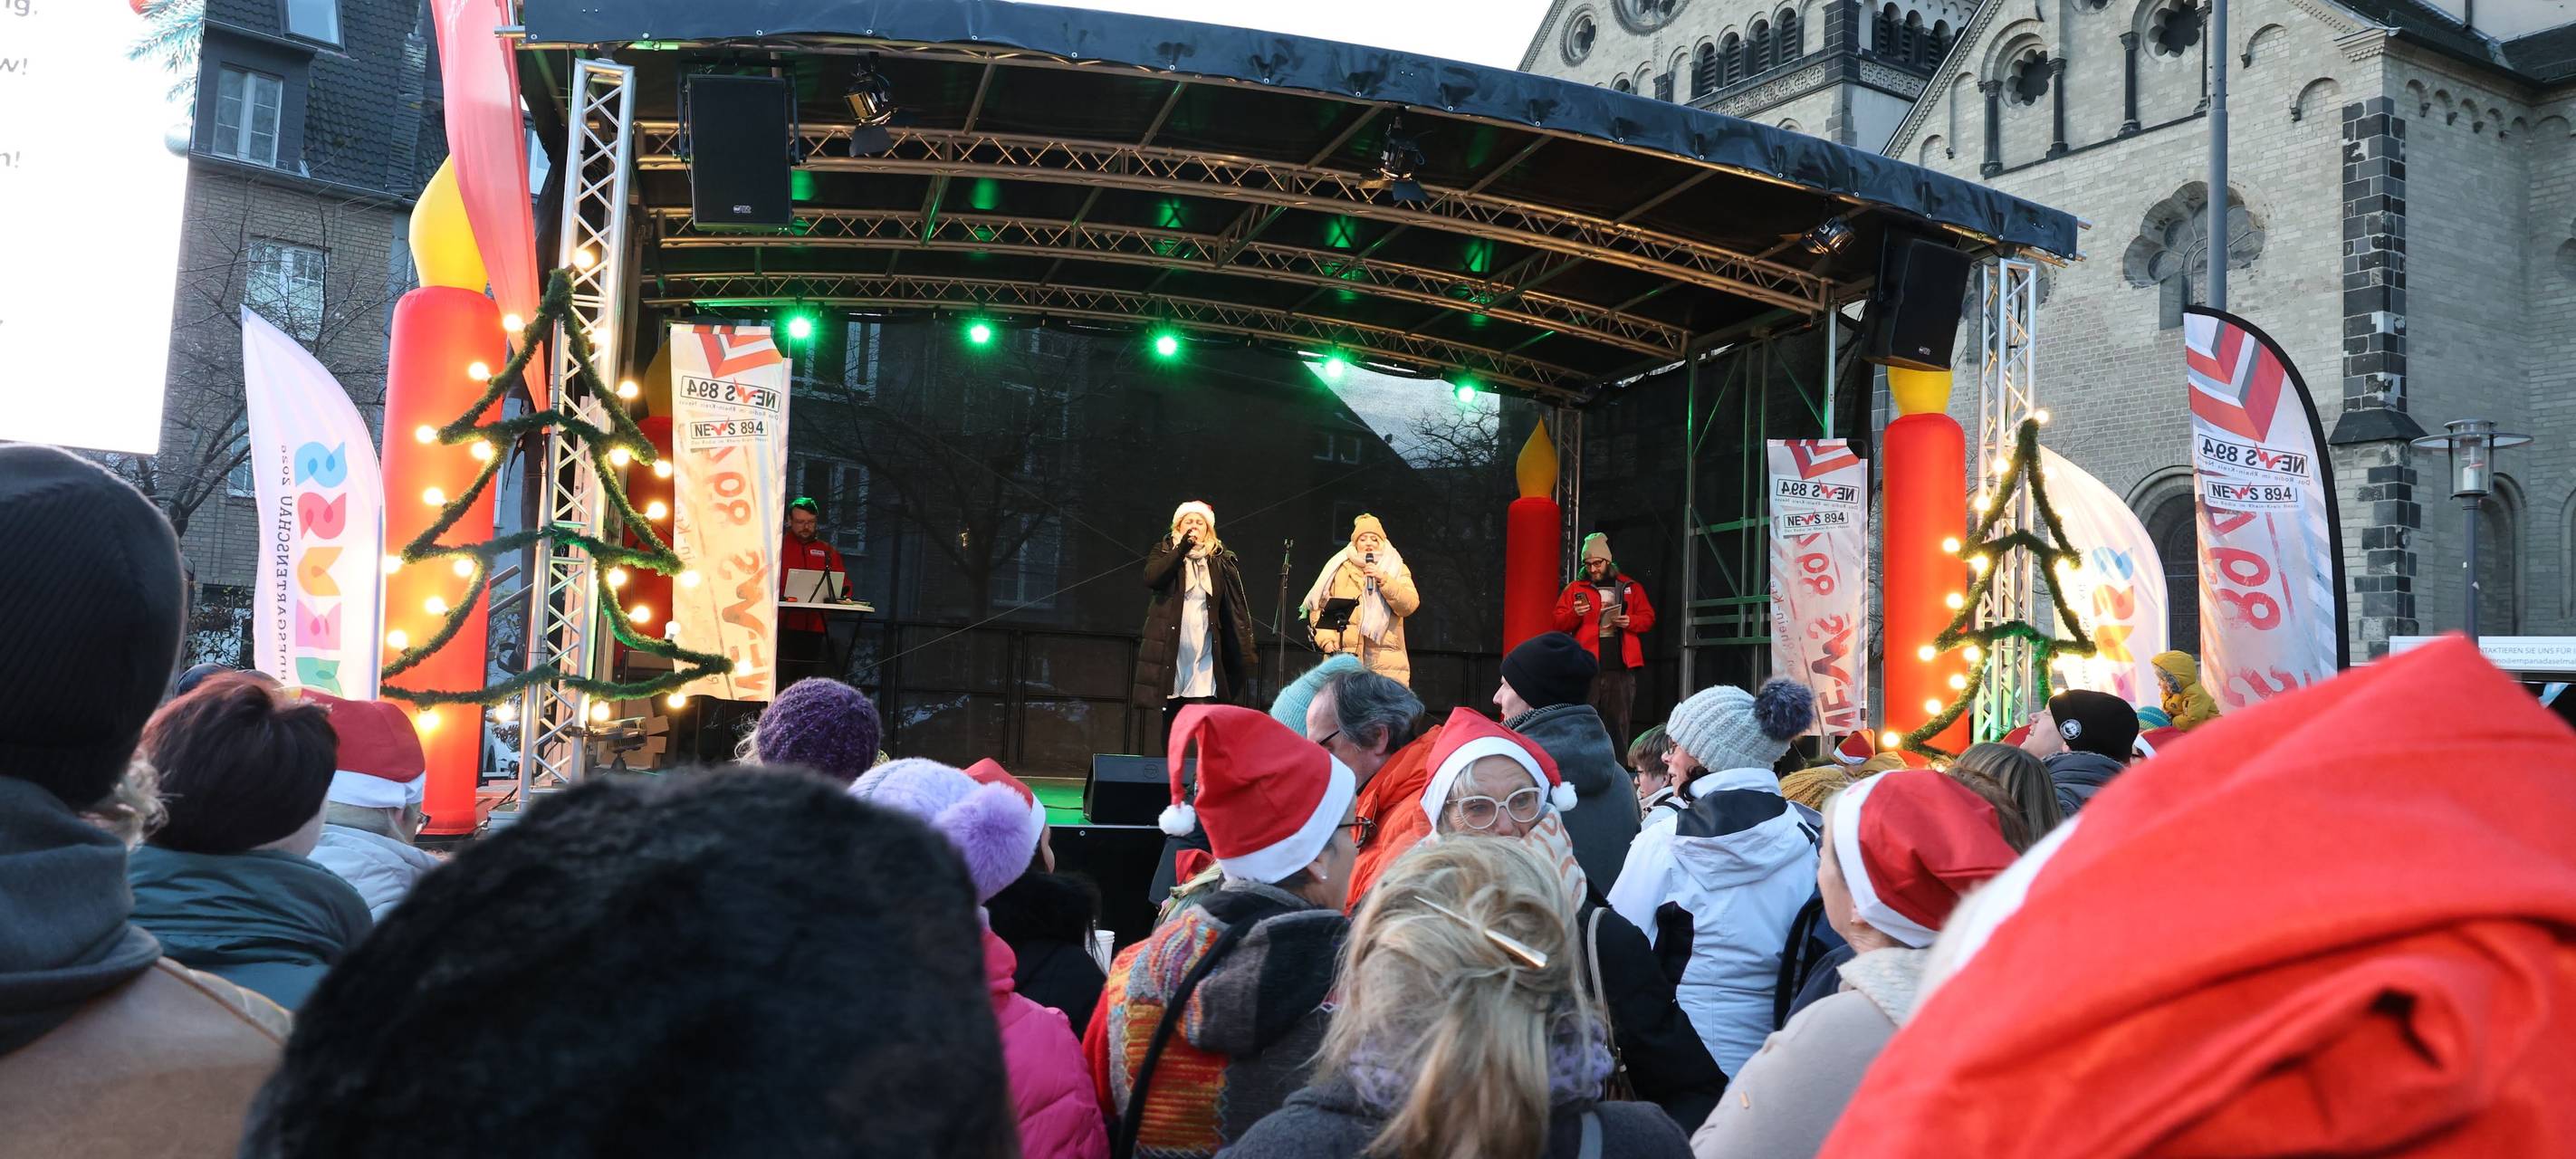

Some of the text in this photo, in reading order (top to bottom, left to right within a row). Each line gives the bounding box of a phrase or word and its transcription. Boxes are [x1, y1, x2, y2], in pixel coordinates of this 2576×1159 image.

[740, 420, 764, 435] 89.4
[2265, 486, 2293, 501] 89.4
[1824, 512, 1845, 523] 89.4
